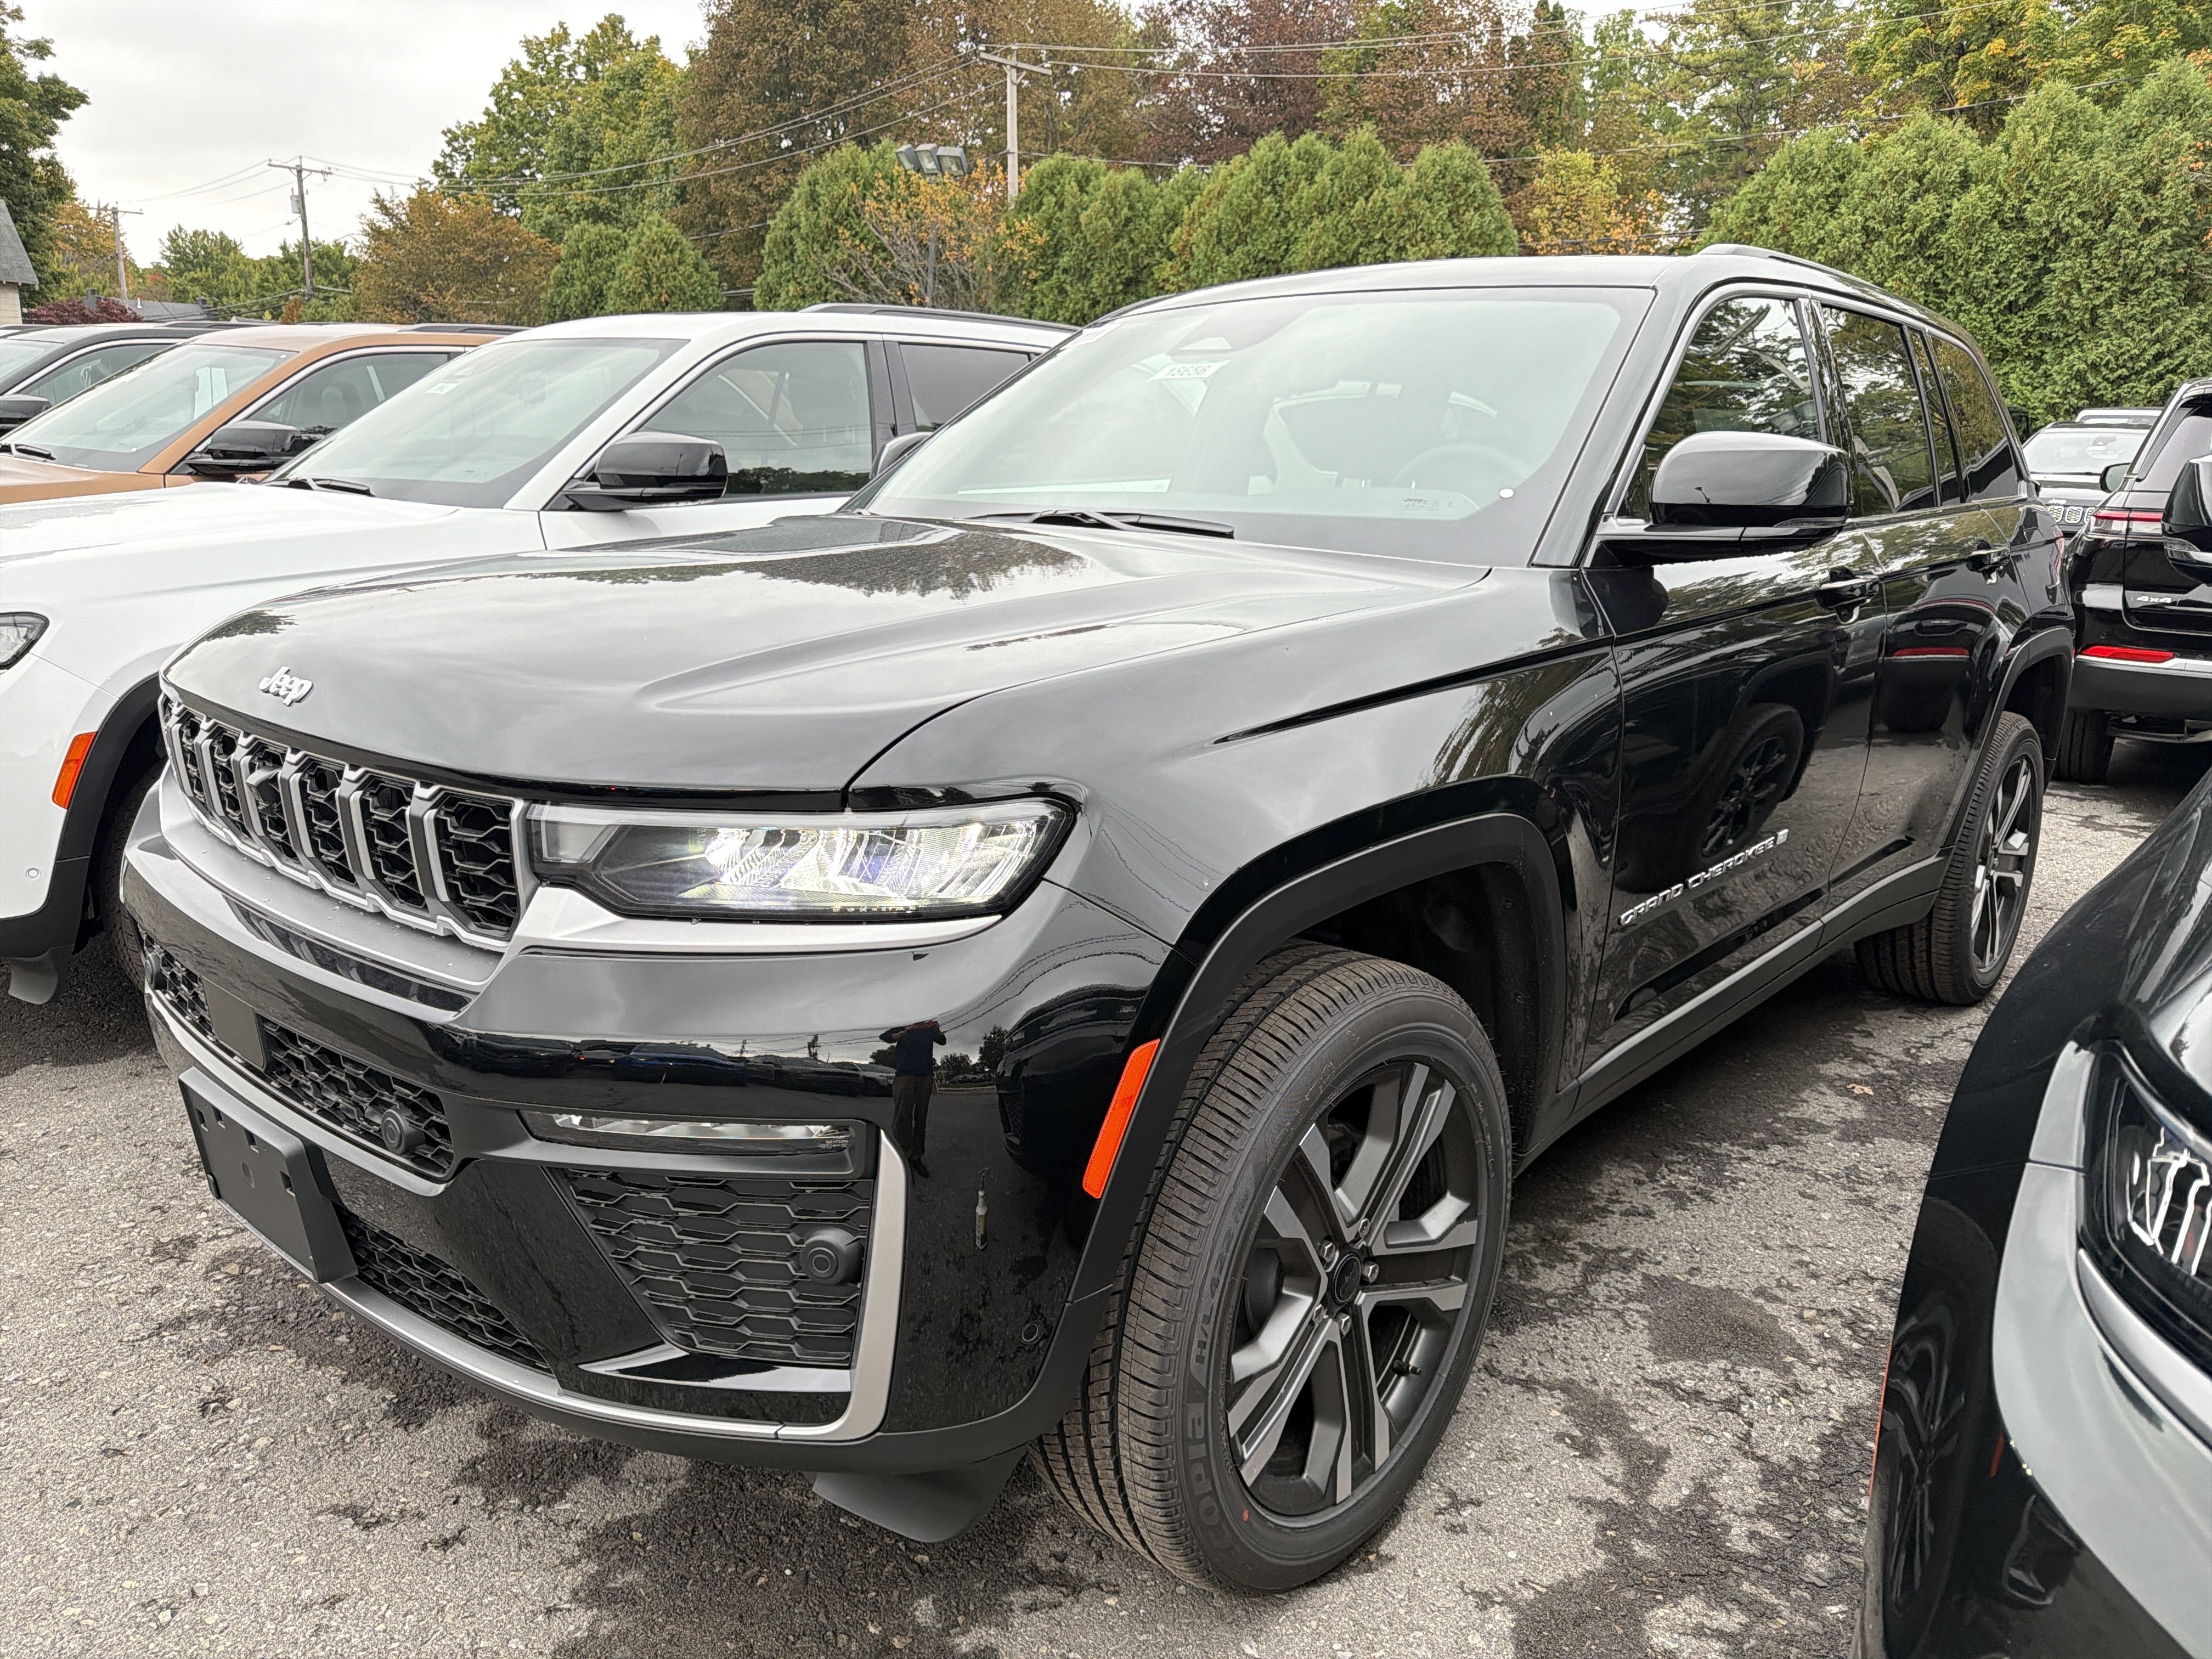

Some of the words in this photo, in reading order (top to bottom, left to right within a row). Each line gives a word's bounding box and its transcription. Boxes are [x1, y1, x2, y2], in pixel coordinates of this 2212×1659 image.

[2136, 595, 2172, 603] 4x4
[258, 665, 314, 707] Jeep
[1619, 883, 1684, 926] GRAND
[1687, 836, 1775, 890] CHEROKEE
